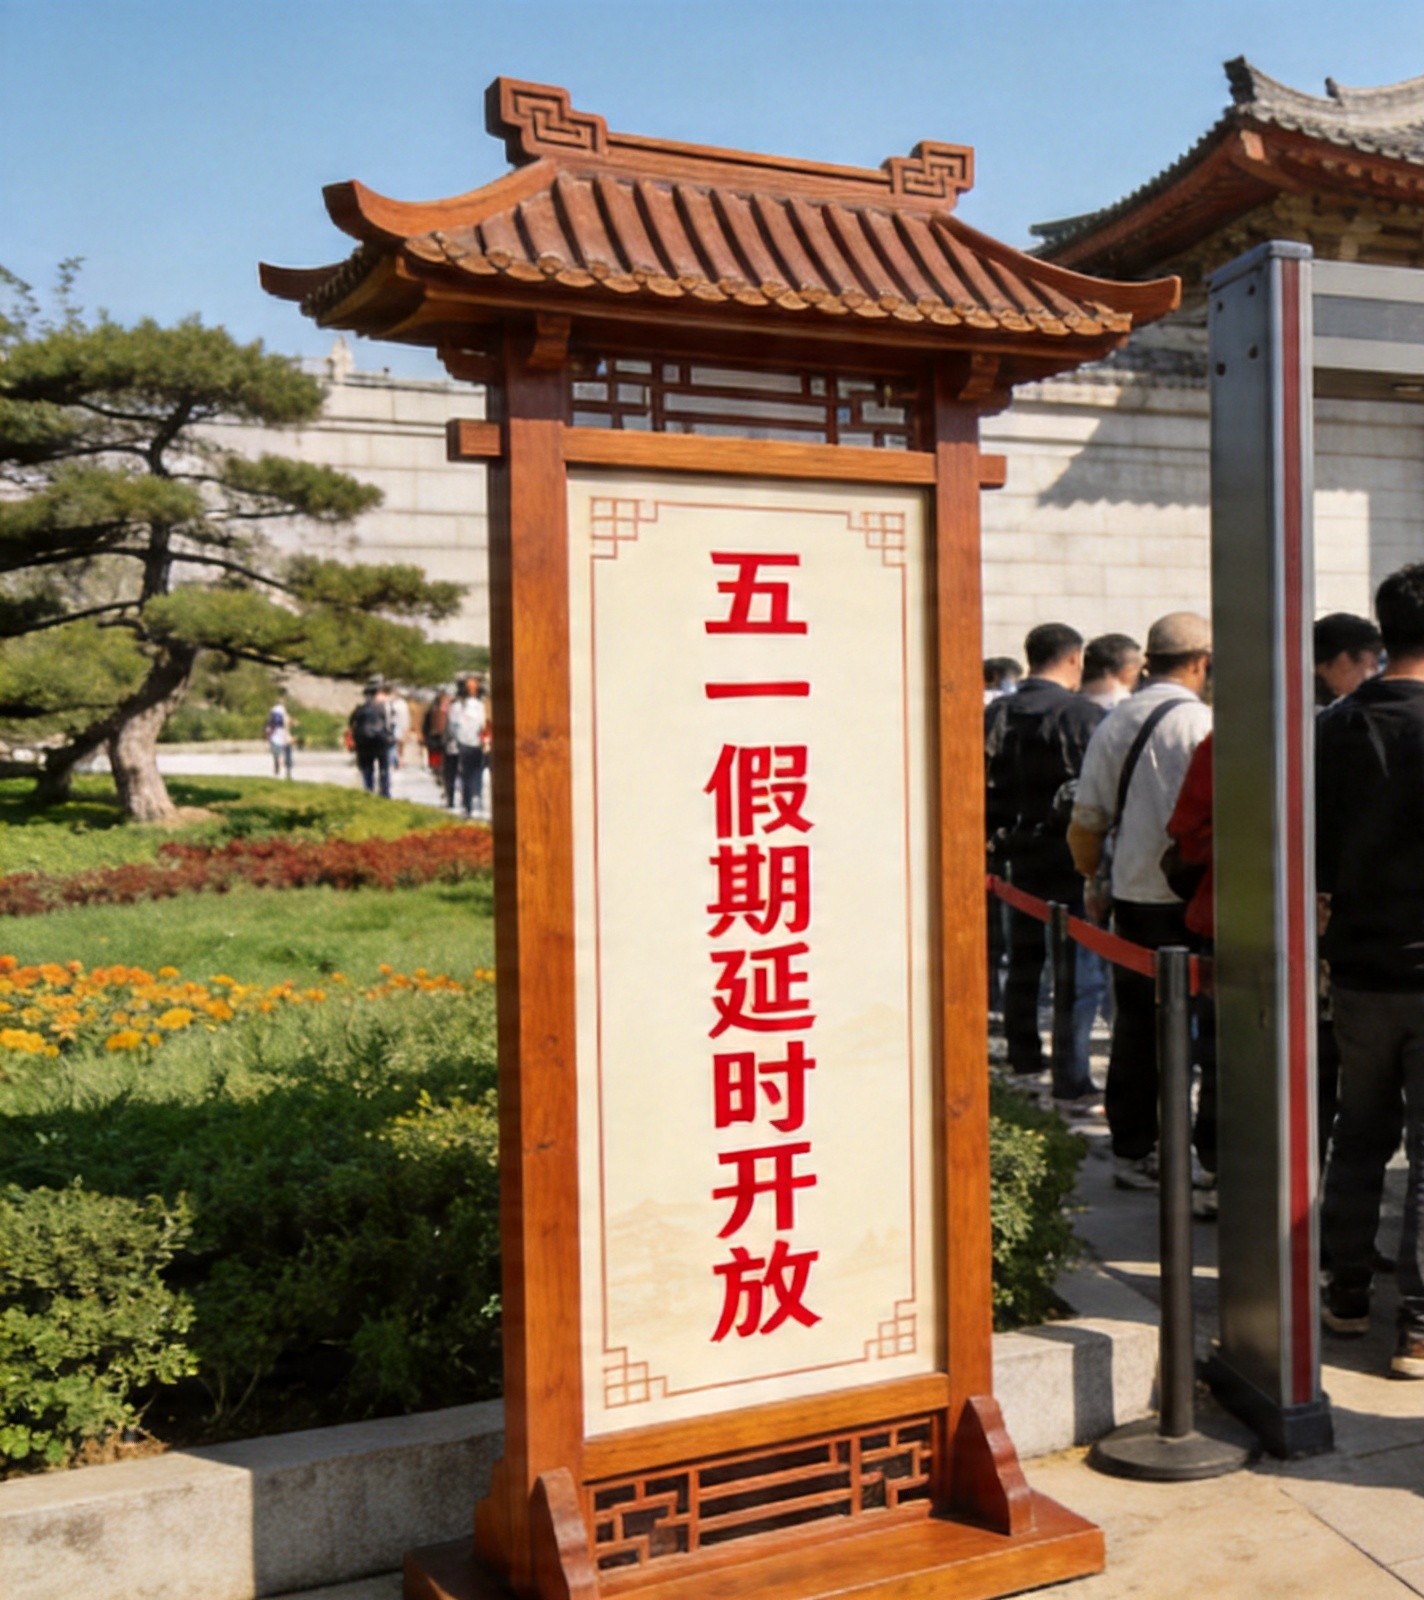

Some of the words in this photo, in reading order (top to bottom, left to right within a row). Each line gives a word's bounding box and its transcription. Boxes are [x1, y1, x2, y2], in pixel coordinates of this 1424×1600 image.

[703, 550, 822, 1343] 五一假期延时开放
